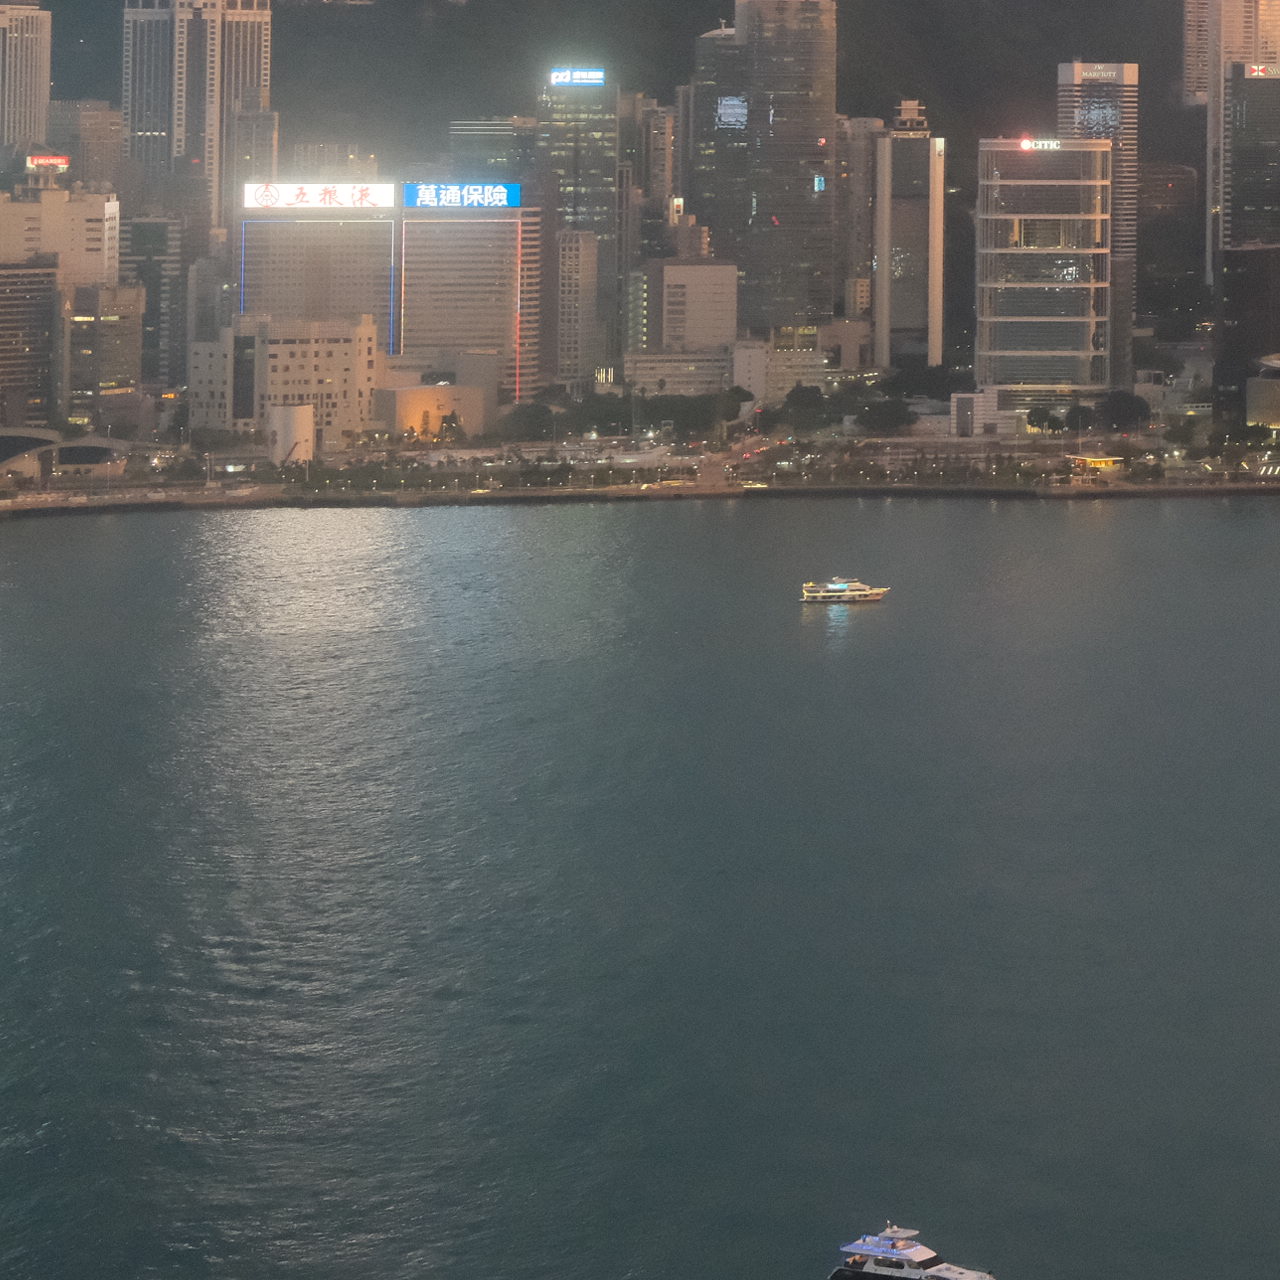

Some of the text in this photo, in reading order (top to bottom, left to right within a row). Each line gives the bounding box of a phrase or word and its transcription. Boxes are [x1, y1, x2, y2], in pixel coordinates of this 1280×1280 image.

[1032, 140, 1061, 150] CITIC
[285, 186, 379, 207] 五粮液
[416, 184, 508, 207] 萬通保險
